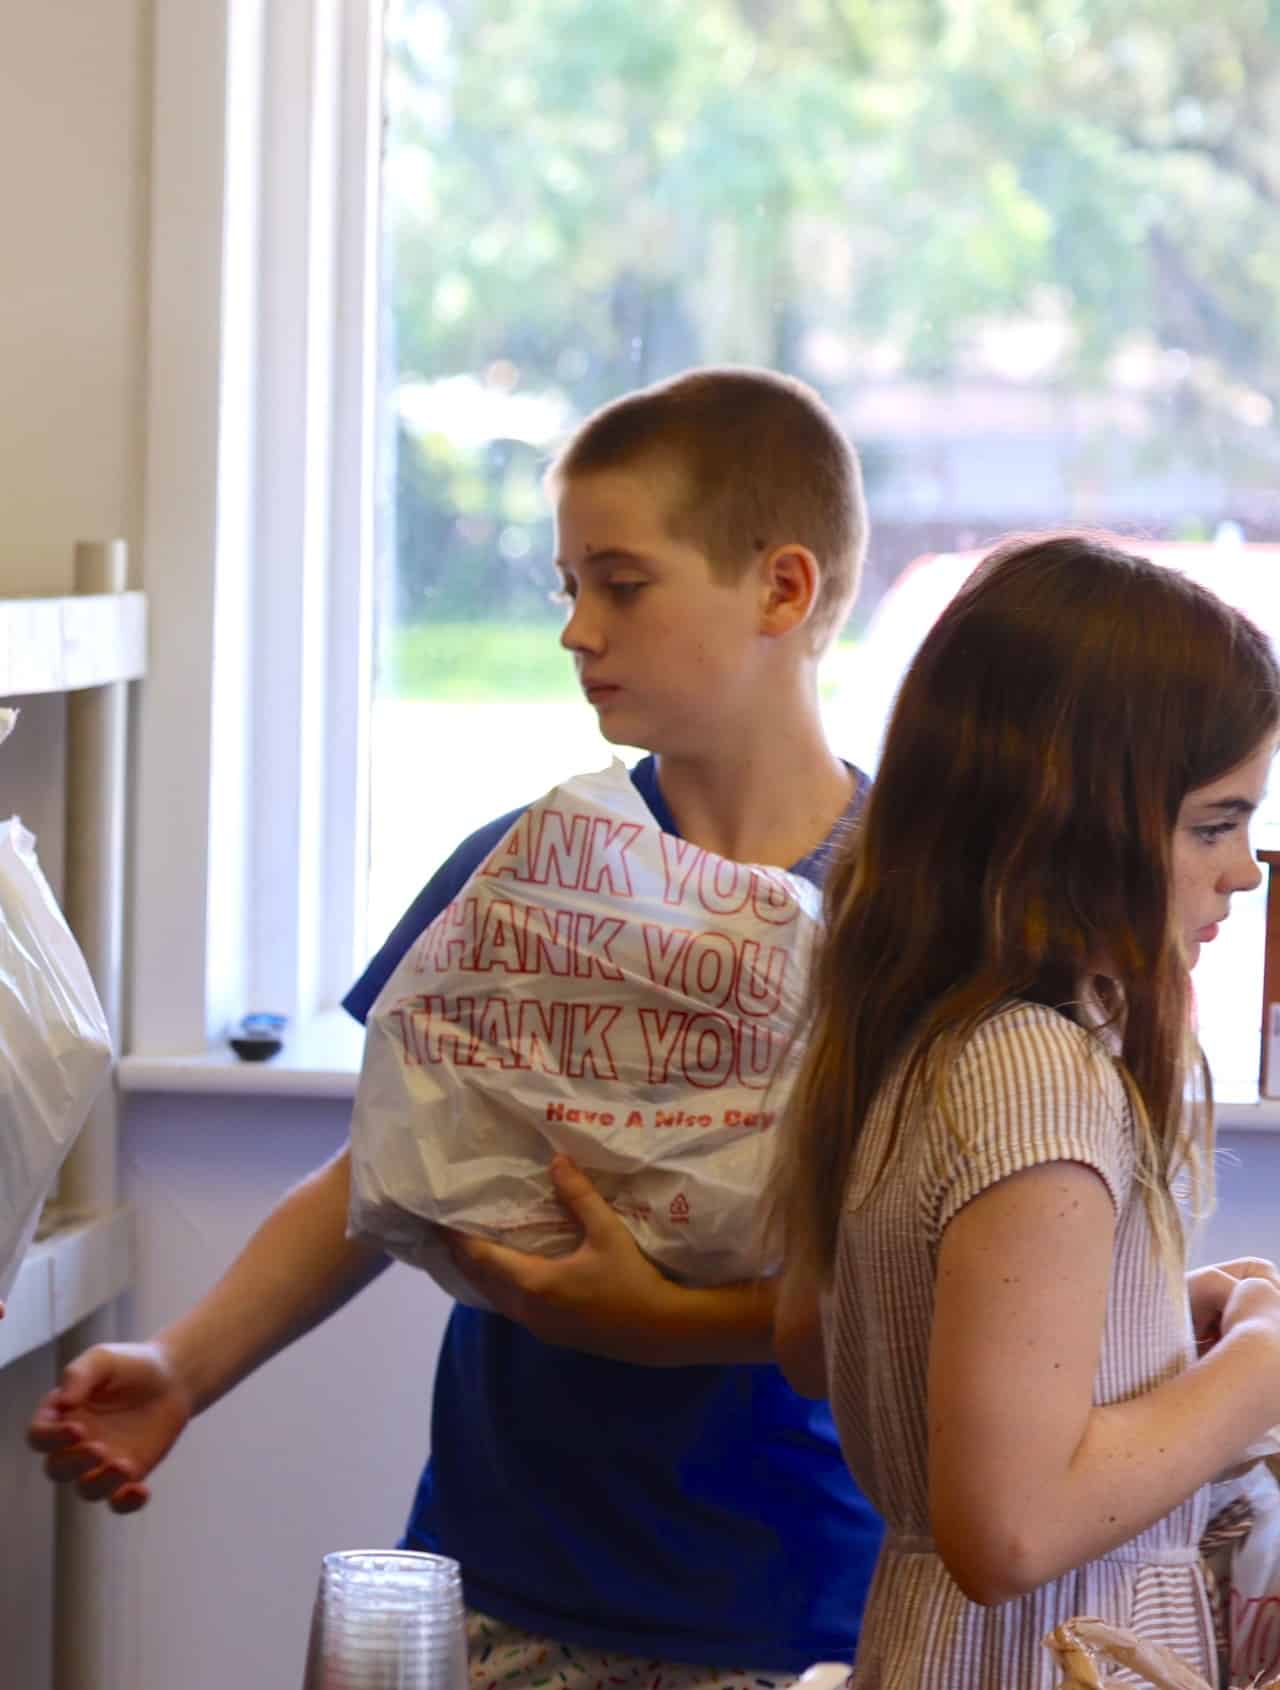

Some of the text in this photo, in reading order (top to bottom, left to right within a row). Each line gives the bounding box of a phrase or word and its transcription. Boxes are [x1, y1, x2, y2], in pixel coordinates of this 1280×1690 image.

[659, 831, 801, 925] YOU
[641, 923, 788, 1018] YOU
[390, 994, 788, 1091] THANK YOU
[545, 1102, 615, 1127] Have
[625, 1109, 644, 1129] A
